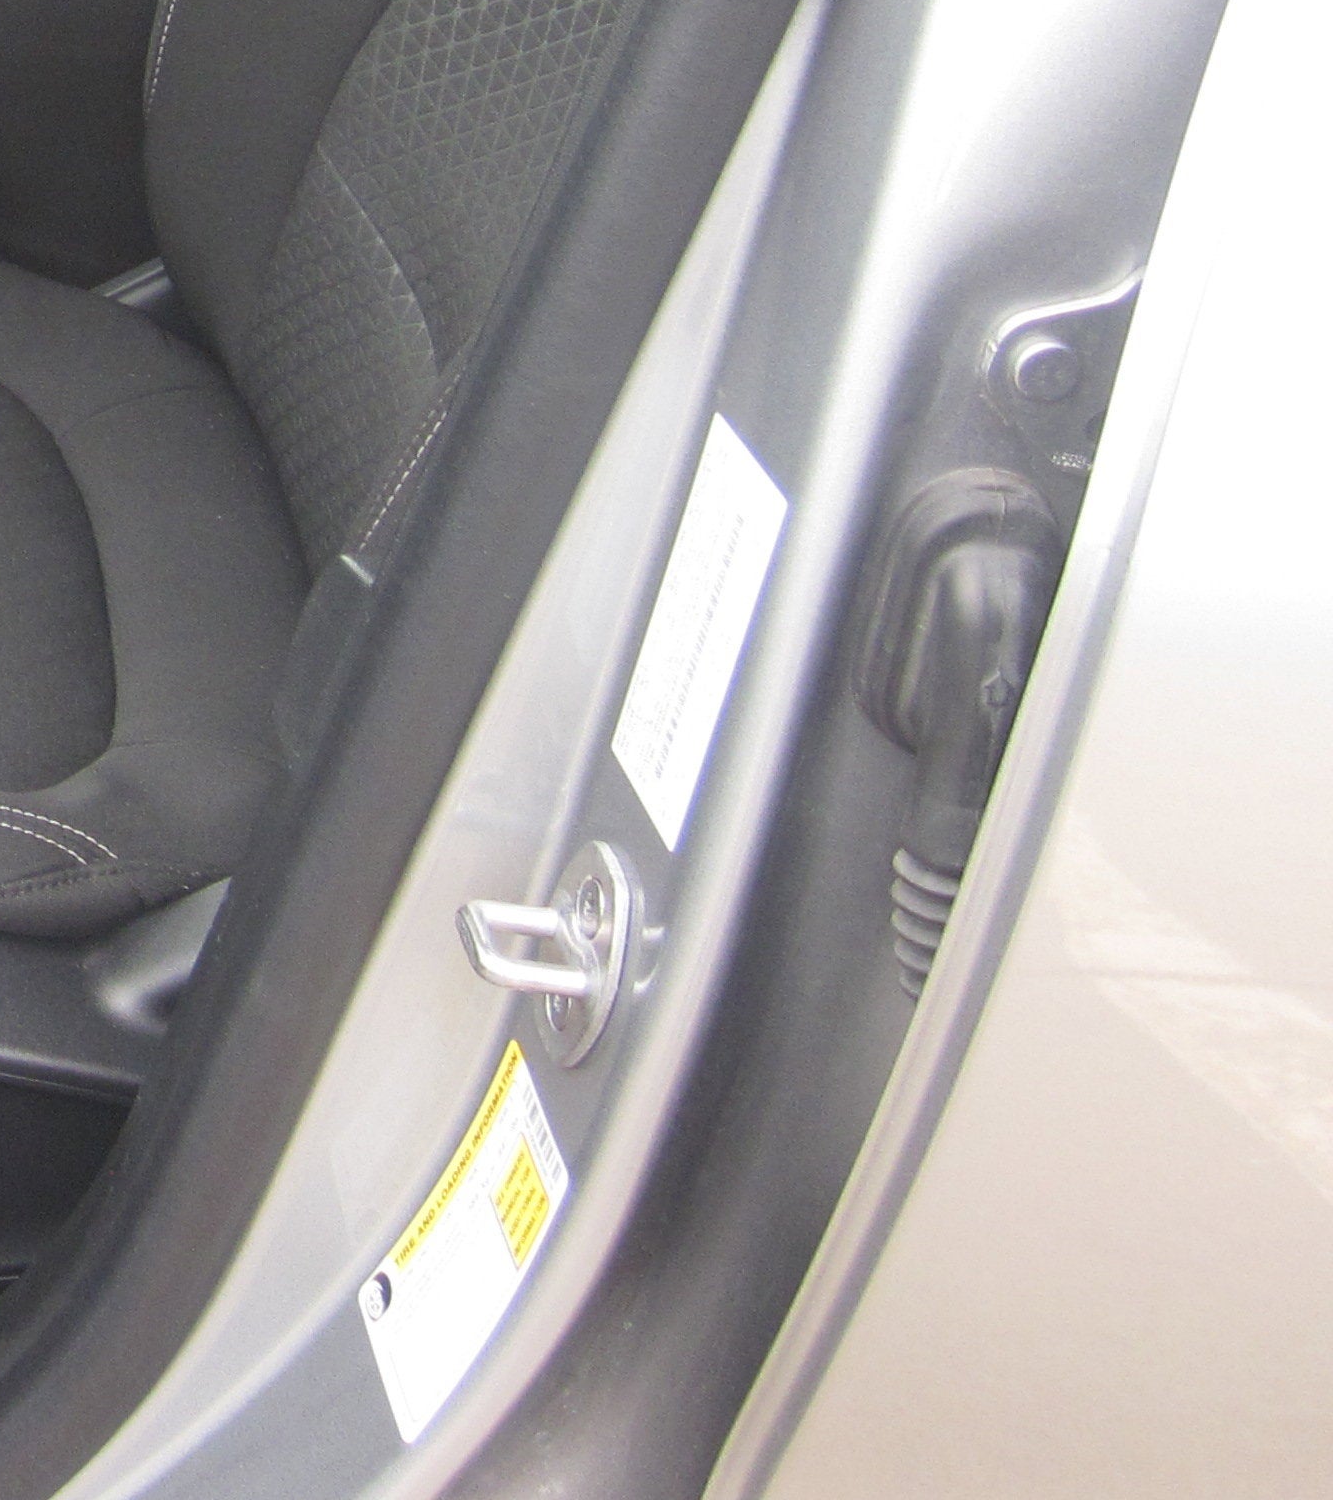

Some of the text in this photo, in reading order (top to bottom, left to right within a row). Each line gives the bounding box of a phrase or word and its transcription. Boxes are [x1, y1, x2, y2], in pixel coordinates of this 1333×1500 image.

[394, 1236, 417, 1267] TIRE
[417, 1209, 436, 1236] AND
[435, 1149, 473, 1209] LOADING
[471, 1051, 519, 1149] INFORMATION
